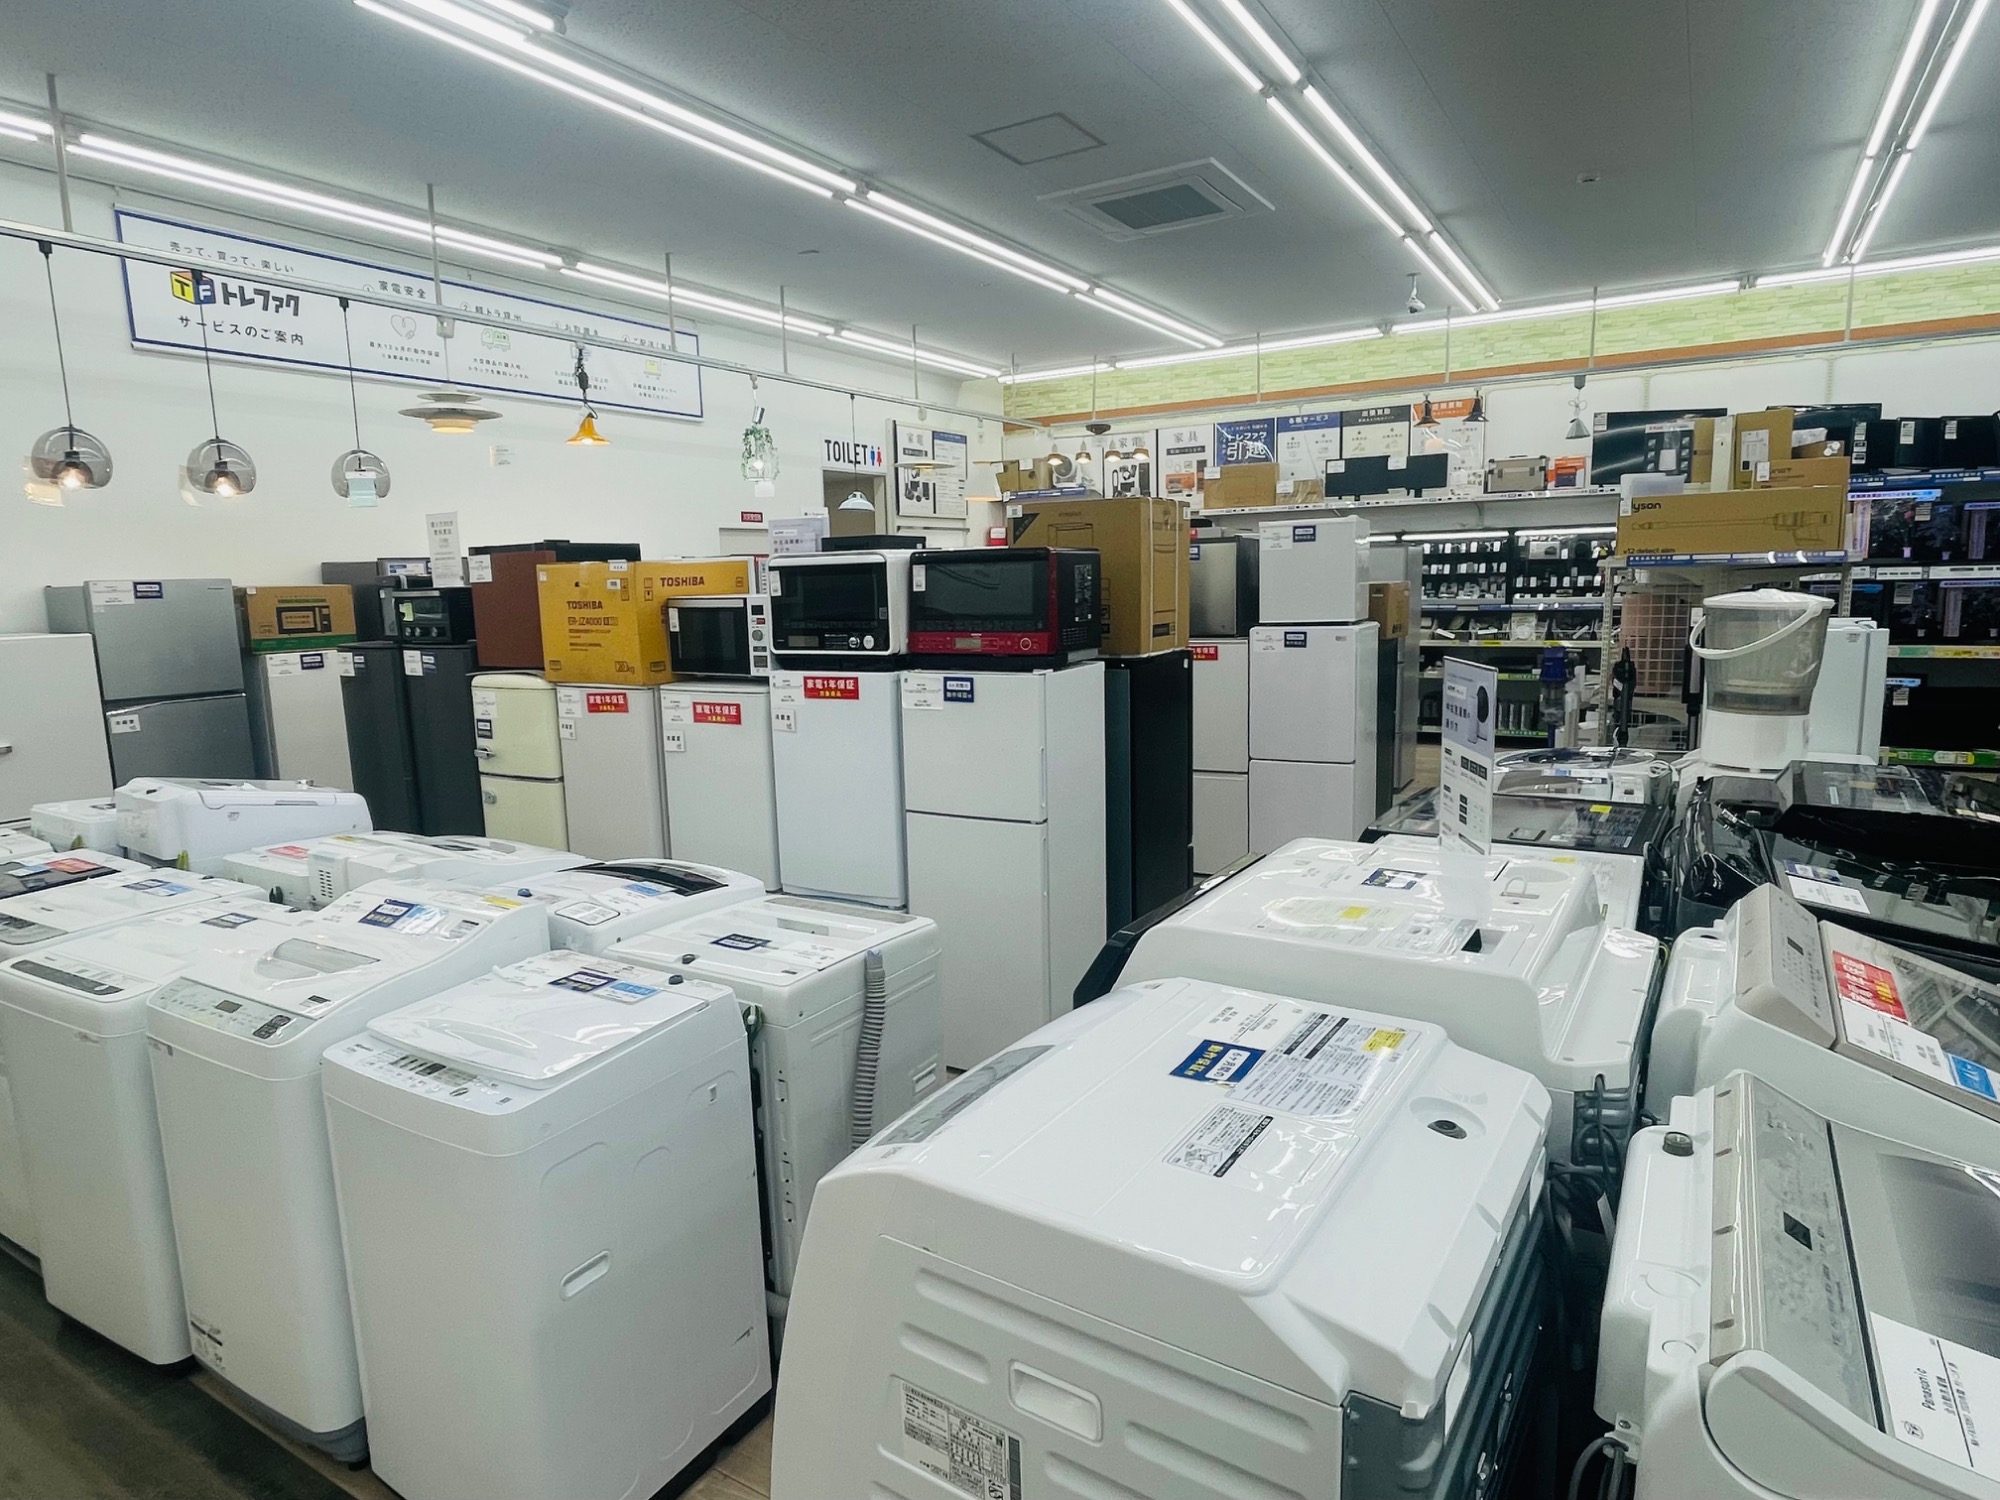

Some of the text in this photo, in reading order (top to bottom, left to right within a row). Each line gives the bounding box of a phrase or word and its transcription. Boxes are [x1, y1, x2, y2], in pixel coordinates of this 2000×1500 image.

[170, 241, 294, 273] 売って、買って、楽しい
[221, 282, 300, 317] トレファク
[178, 315, 304, 346] サービスのご案内
[824, 438, 868, 467] TOILET
[1632, 497, 1660, 513] yson
[660, 576, 705, 588] TOSHIBA
[566, 600, 604, 610] TOSHIBA
[806, 678, 855, 690] 家電1年保証
[588, 694, 625, 705] 家電1年保証
[695, 704, 738, 716] 家電1年保証
[1913, 1367, 1936, 1412] Panasonic
